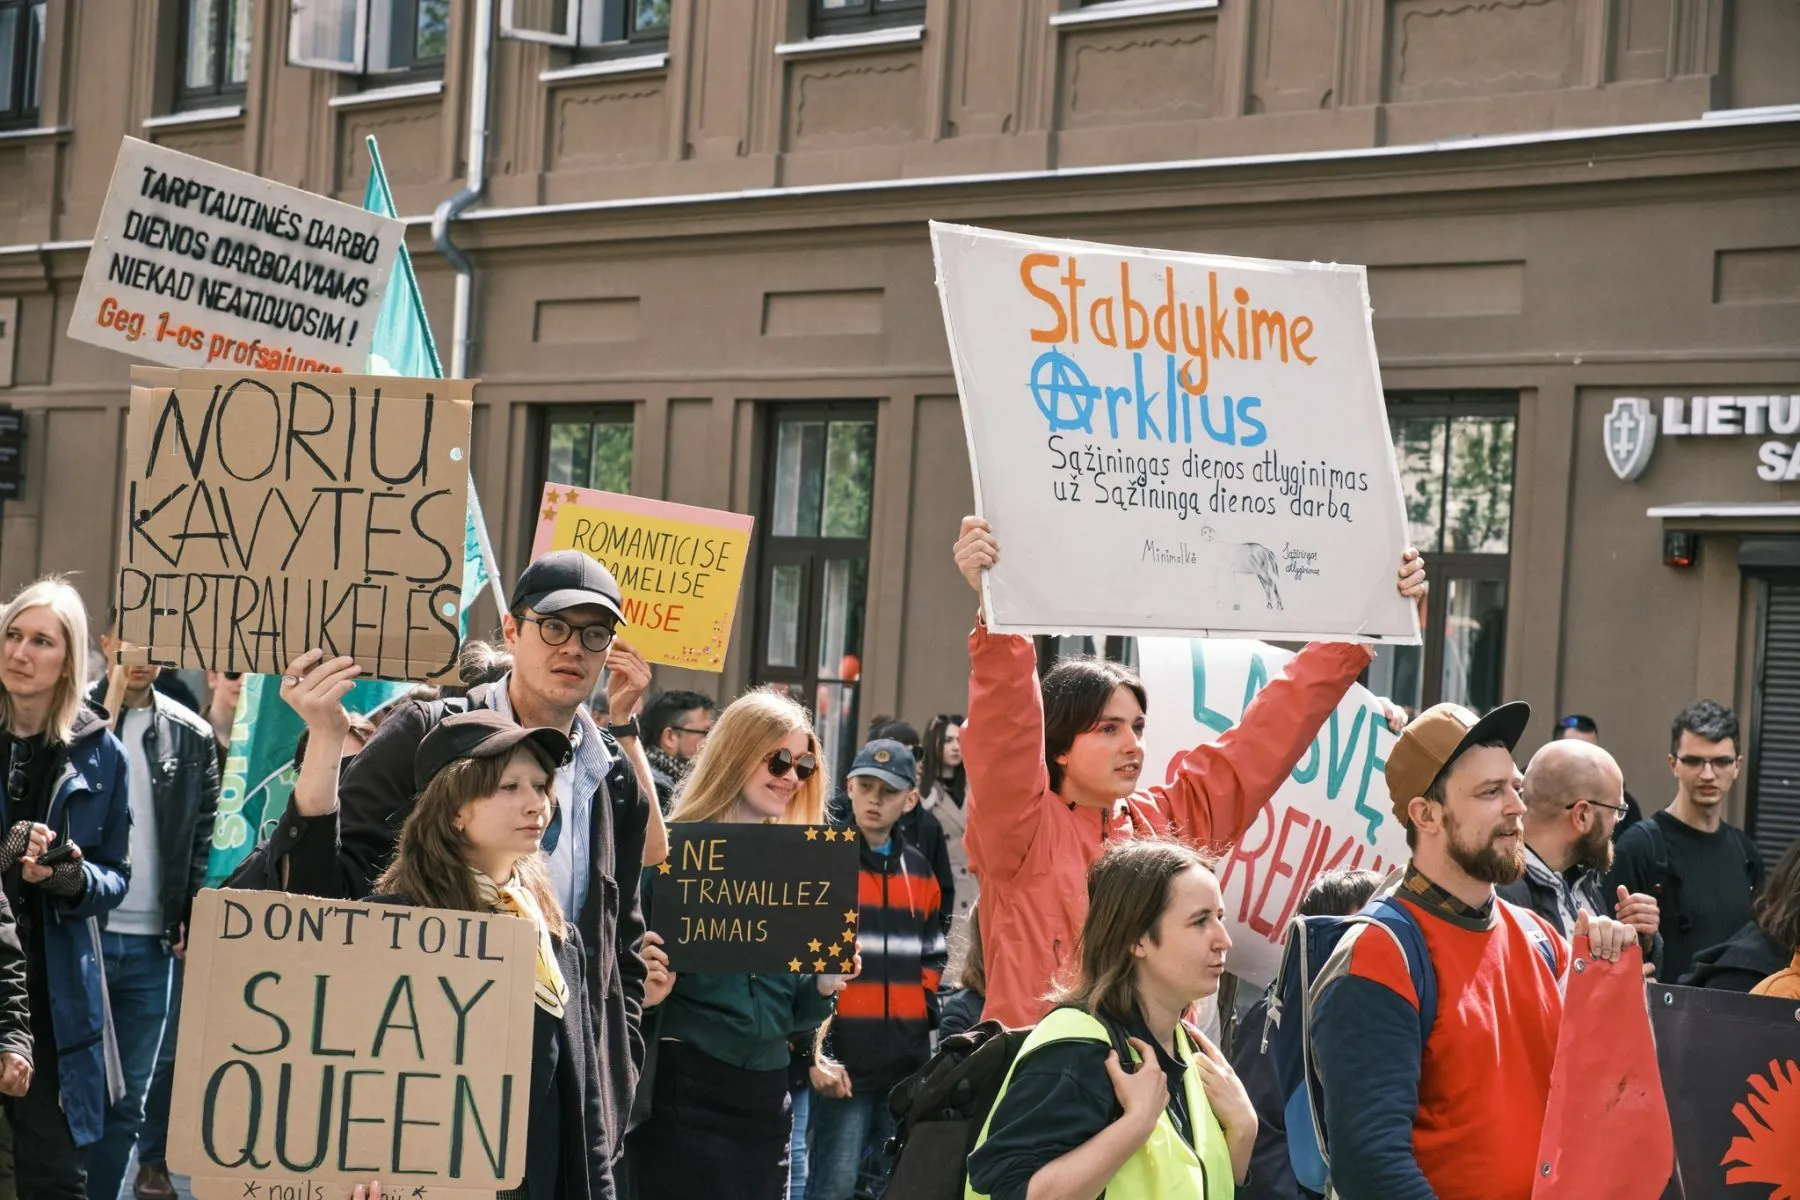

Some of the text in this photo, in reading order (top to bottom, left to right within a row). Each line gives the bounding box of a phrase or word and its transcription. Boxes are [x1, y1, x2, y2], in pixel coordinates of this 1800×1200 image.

[140, 166, 381, 265] TARPTAUTINĖS DARBO
[122, 209, 370, 308] DIENOS DARBDAVIAMS
[97, 297, 146, 342] Geg.
[156, 312, 206, 351] 1-os
[108, 252, 195, 302] NIEKAD
[197, 277, 345, 344] NEATIDUOSIM
[1019, 252, 1318, 396] Stabdykime
[146, 378, 435, 487] NORIU
[1024, 344, 1268, 447] Arklius
[1661, 394, 1800, 436] LIETU
[1048, 435, 1369, 496] Sąžiningas dienos atlyginimas
[1053, 472, 1353, 523] už Sąžiningą dienos darbą
[129, 478, 453, 585] KAVYTĖS
[572, 518, 732, 572] ROMANTICISE
[115, 566, 463, 682] PERTRAUKĖLĖS
[621, 597, 684, 633] NISE
[676, 878, 832, 906] TRAVAILLEZ
[681, 839, 728, 872] NE
[218, 898, 505, 963] DON'T TOIL
[677, 916, 769, 945] JAMAIS
[231, 970, 497, 1066] SLAY
[201, 1059, 514, 1180] QUEEN
